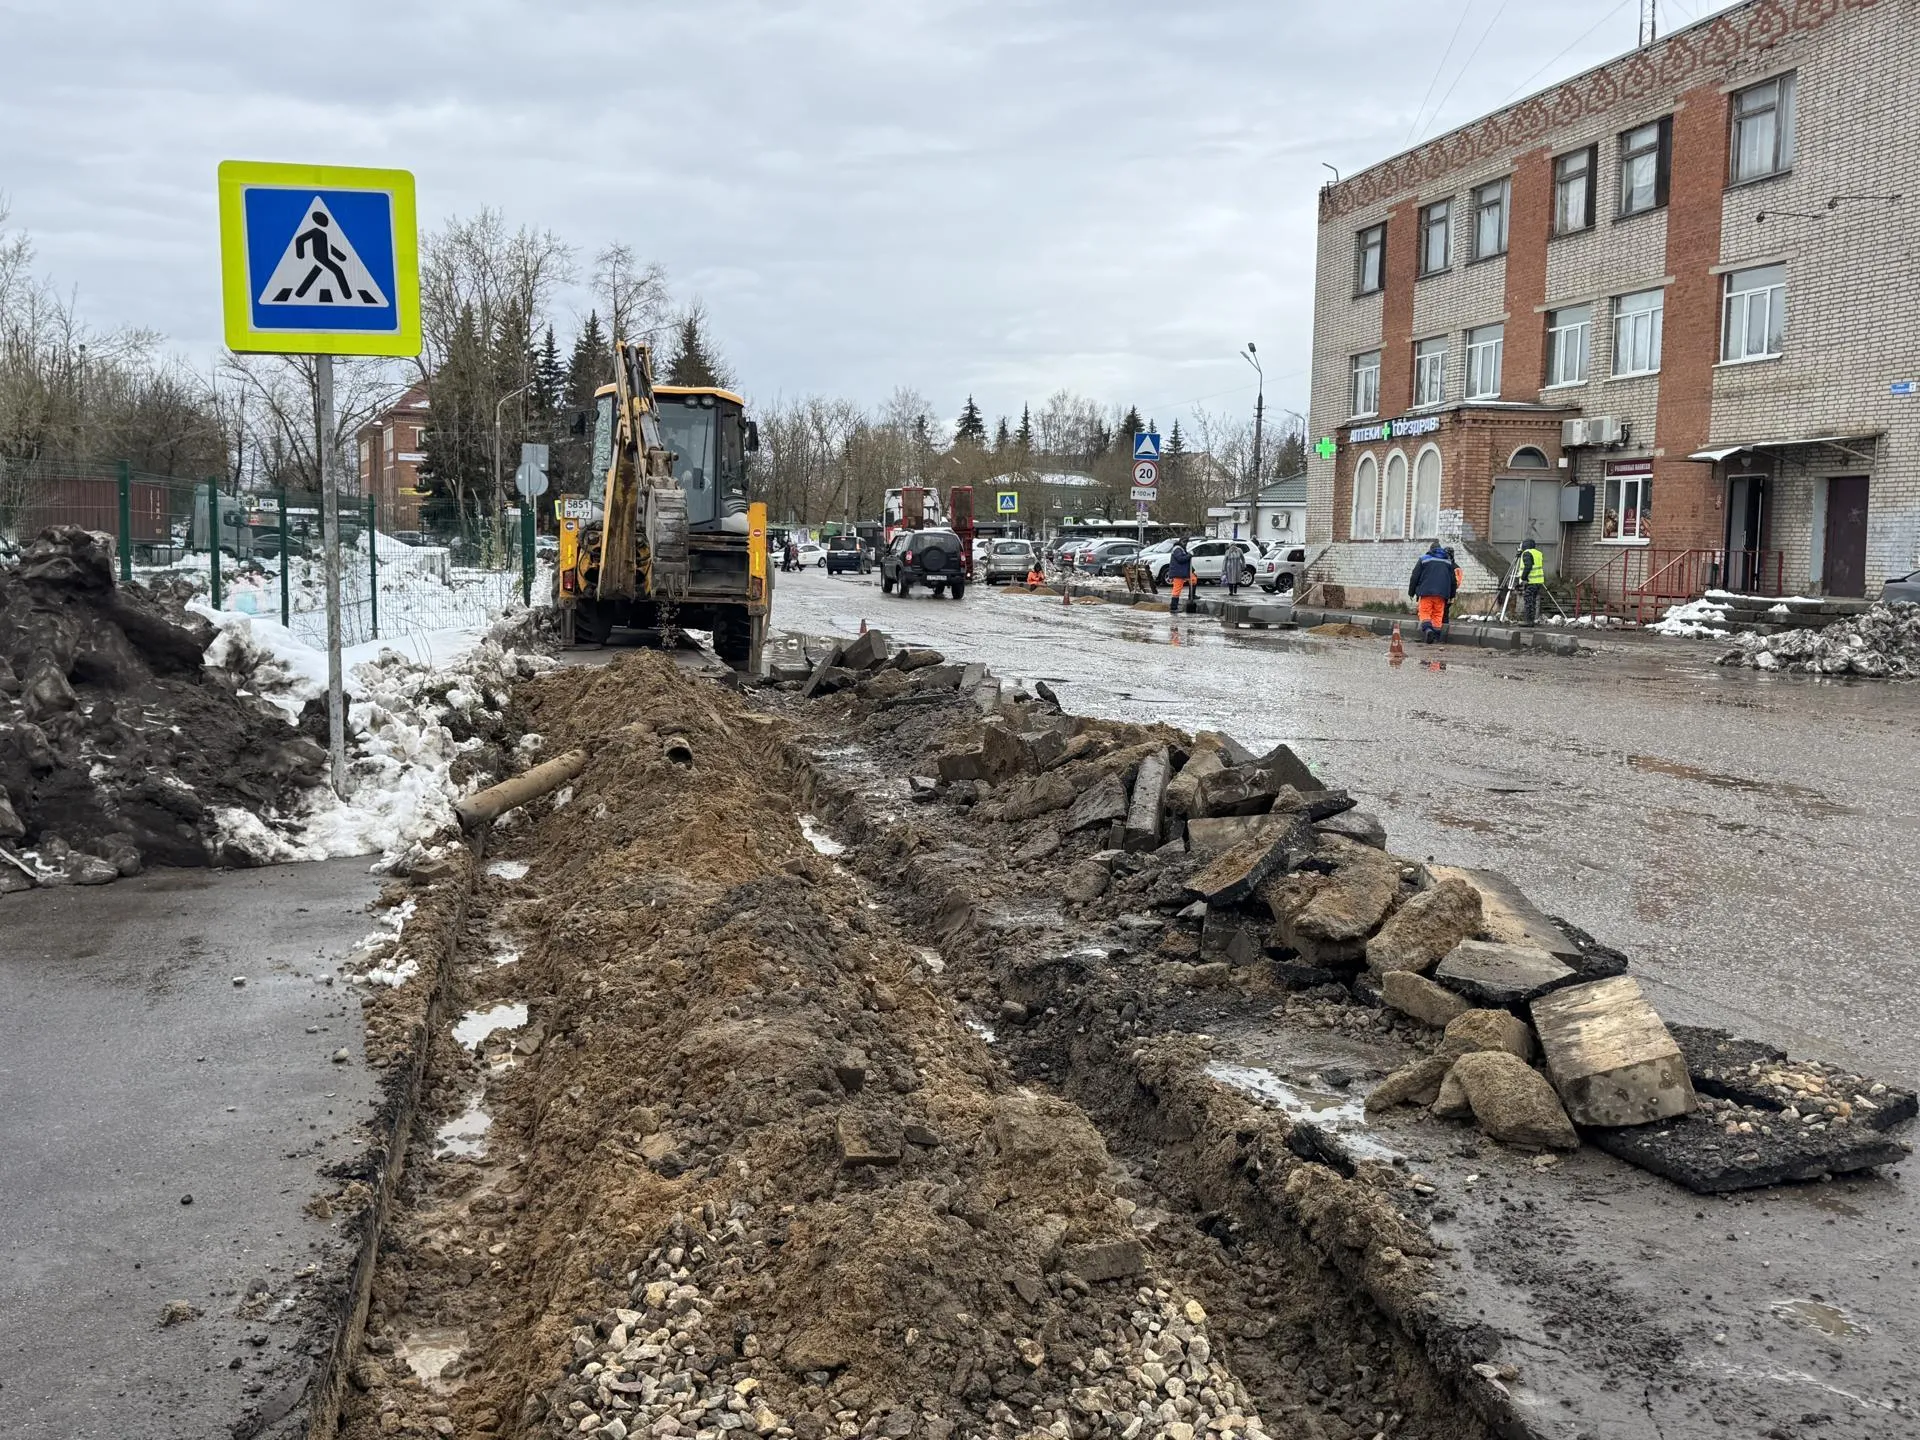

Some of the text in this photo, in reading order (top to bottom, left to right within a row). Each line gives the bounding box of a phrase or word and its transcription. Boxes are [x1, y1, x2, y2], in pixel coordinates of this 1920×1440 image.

[1350, 418, 1437, 442] АПТЕКИ ГОРЗДРАВ
[1139, 468, 1153, 479] 20
